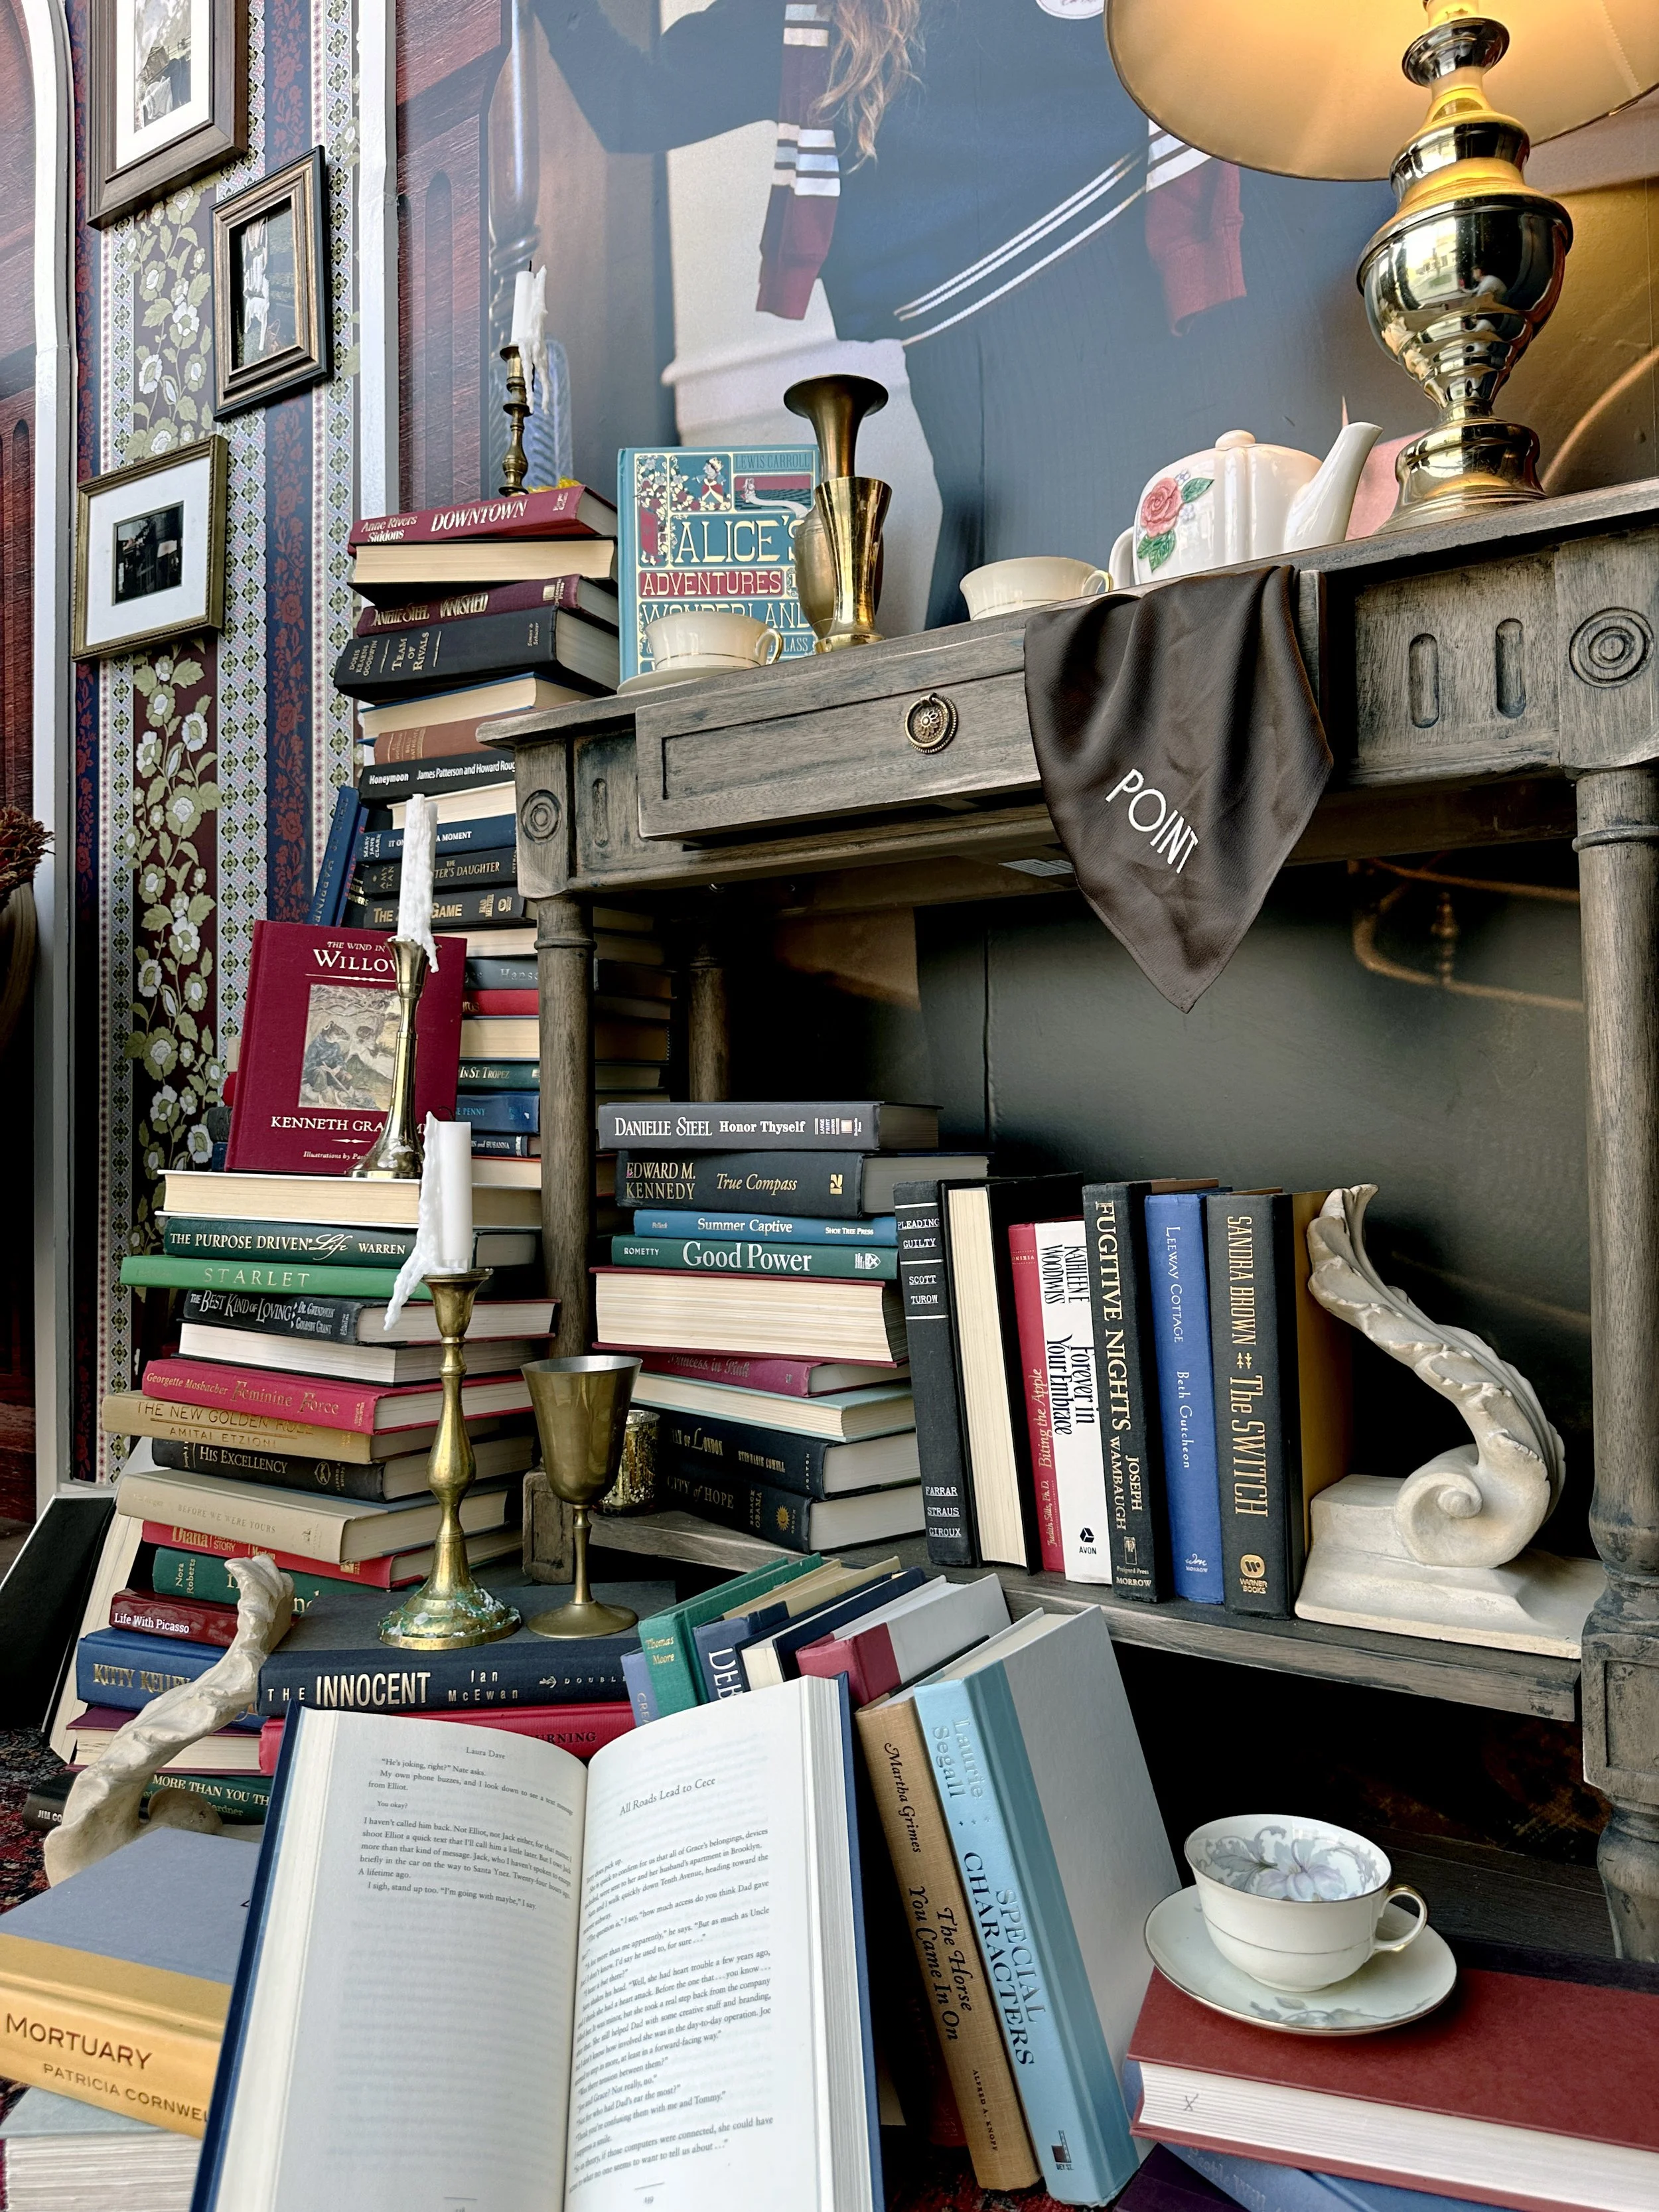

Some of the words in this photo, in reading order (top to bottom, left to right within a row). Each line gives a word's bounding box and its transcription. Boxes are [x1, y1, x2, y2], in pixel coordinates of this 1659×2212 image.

[735, 453, 765, 470] LEWIS
[767, 452, 811, 469] CARROLL
[361, 520, 387, 533] Anne
[388, 514, 417, 528] Rivers
[430, 499, 529, 532] DOWNTOWN
[367, 529, 405, 543] Siddons
[642, 570, 782, 596] ADVENTURES
[439, 593, 489, 619] VANISHED
[348, 649, 360, 670] DORIS
[356, 645, 369, 673] KEARNS
[363, 640, 378, 676] GOODWIN
[392, 638, 408, 672] TEAM
[408, 646, 416, 659] OF
[413, 632, 429, 672] RIVALS
[369, 773, 409, 785] Honeymoon
[417, 771, 435, 780] James
[435, 767, 464, 778] Patterson
[464, 764, 476, 775] and
[476, 762, 500, 774] Howard
[1105, 769, 1199, 874] POINT
[441, 831, 472, 842] MOMENT
[456, 861, 500, 877] DAUGHTER
[374, 907, 394, 923] THE
[431, 902, 463, 919] GAME
[347, 942, 372, 951] WIND
[374, 944, 386, 953] IN
[270, 1116, 348, 1132] KENNETH
[614, 1117, 672, 1137] DANIELLE
[676, 1116, 713, 1137] STEEL
[719, 1120, 758, 1133] Honor
[760, 1120, 806, 1135] Thyself
[303, 1150, 342, 1159] Illustrations
[626, 1162, 679, 1180] EDWARD
[682, 1162, 696, 1180] M.
[626, 1182, 695, 1200] KENNEDY
[716, 1173, 743, 1190] True
[746, 1173, 798, 1196] Compass
[697, 1217, 745, 1231] Summer
[749, 1218, 794, 1236] Captive
[856, 1227, 874, 1236] PRESS
[897, 1218, 940, 1230] PLEADING
[170, 1233, 192, 1244] THE
[195, 1234, 252, 1250] PURPOSE
[308, 1234, 354, 1260] Life
[358, 1243, 406, 1254] WARREN
[624, 1247, 660, 1256] ROMETTY
[682, 1240, 743, 1269] Good
[747, 1243, 812, 1272] Power
[902, 1238, 937, 1249] GUILTY
[1166, 1226, 1181, 1280] LEEWAY
[1227, 1216, 1254, 1282] SANDRA
[1040, 1244, 1066, 1304] WOODIWISS
[1095, 1201, 1123, 1322] FUGITIVE
[204, 1268, 310, 1288] STARLET
[908, 1274, 937, 1285] SCOTT
[190, 1293, 202, 1303] THE
[199, 1290, 227, 1313] BEST
[224, 1293, 250, 1317] KIND
[249, 1303, 257, 1313] OF
[255, 1297, 292, 1323] LOVING
[910, 1294, 939, 1305] TUROW
[1170, 1284, 1184, 1343] COTTAGE
[1229, 1286, 1256, 1346] BROWN
[1047, 1333, 1073, 1374] Your
[1031, 1368, 1049, 1407] Apple
[1070, 1345, 1096, 1404] Forever
[1106, 1329, 1131, 1432] NIGHTS
[1177, 1370, 1192, 1399] Beth
[147, 1372, 183, 1388] Georgette
[184, 1378, 228, 1396] Mosbacher
[230, 1380, 293, 1408] Feminine
[297, 1392, 340, 1415] Force
[1050, 1372, 1072, 1436] Embrace
[1229, 1374, 1263, 1414] The
[135, 1401, 163, 1417] THE
[170, 1406, 203, 1421] NEW
[208, 1410, 267, 1428] GOLDEN
[1035, 1408, 1046, 1428] the
[169, 1427, 213, 1440] AMITAI
[222, 1434, 276, 1449] ETZIONI
[1039, 1428, 1054, 1469] Biting
[1179, 1404, 1194, 1469] Gutcheon
[199, 1446, 218, 1462] HIS
[220, 1450, 288, 1474] EXCELLENCY
[1231, 1419, 1269, 1518] SWITCH
[925, 1487, 958, 1497] FARRAR
[1110, 1436, 1127, 1531] WAMBAUGH
[1125, 1456, 1143, 1512] JOSEPH
[704, 1486, 734, 1509] HOPE
[178, 1504, 207, 1519] BEFORE
[210, 1511, 222, 1521] WE
[224, 1514, 247, 1527] WERE
[250, 1520, 277, 1534] YOURS
[927, 1507, 960, 1517] STRAUS
[929, 1527, 962, 1538] GIROUX
[214, 1540, 236, 1552] STORY
[1079, 1546, 1097, 1554] AVON
[175, 1562, 185, 1588] Nora
[186, 1558, 197, 1595] Roberts
[1116, 1578, 1151, 1587] MORROW
[1240, 1578, 1267, 1588] WARNER
[114, 1612, 132, 1625] Life
[133, 1615, 155, 1629] With
[156, 1618, 190, 1634] Picasso
[645, 1636, 675, 1650] Thomas
[652, 1653, 675, 1666] Moore
[93, 1663, 137, 1687] KITTY
[470, 1669, 499, 1684] Ian
[267, 1687, 305, 1702] THE
[315, 1670, 431, 1708] INNOCENT
[447, 1688, 518, 1703] McEwan
[466, 1746, 486, 1756] Laura
[488, 1749, 506, 1759] Dave
[932, 1726, 967, 1799] Segall
[954, 1718, 985, 1800] Laurie
[152, 1774, 186, 1790] MORE
[188, 1781, 224, 1798] THAN
[225, 1789, 251, 1803] YOU
[413, 1773, 435, 1783] phone
[620, 1803, 631, 1816] All
[632, 1794, 658, 1810] Roads
[659, 1785, 681, 1801] Lead
[683, 1784, 693, 1793] to
[695, 1777, 717, 1790] Cece
[884, 1742, 910, 1803] Martha
[898, 1805, 922, 1854] Grimes
[936, 1907, 958, 1946] The
[948, 1949, 974, 2012] Horse
[908, 1885, 928, 1922] You
[915, 1927, 942, 1978] Came
[964, 1851, 1035, 2066] CHARACTERS
[995, 1888, 1046, 2024] SPECIAL
[934, 1982, 953, 2005] In
[942, 2010, 960, 2041] On
[6, 2012, 153, 2070] MORTUARY
[42, 2063, 121, 2097] PATRICIA
